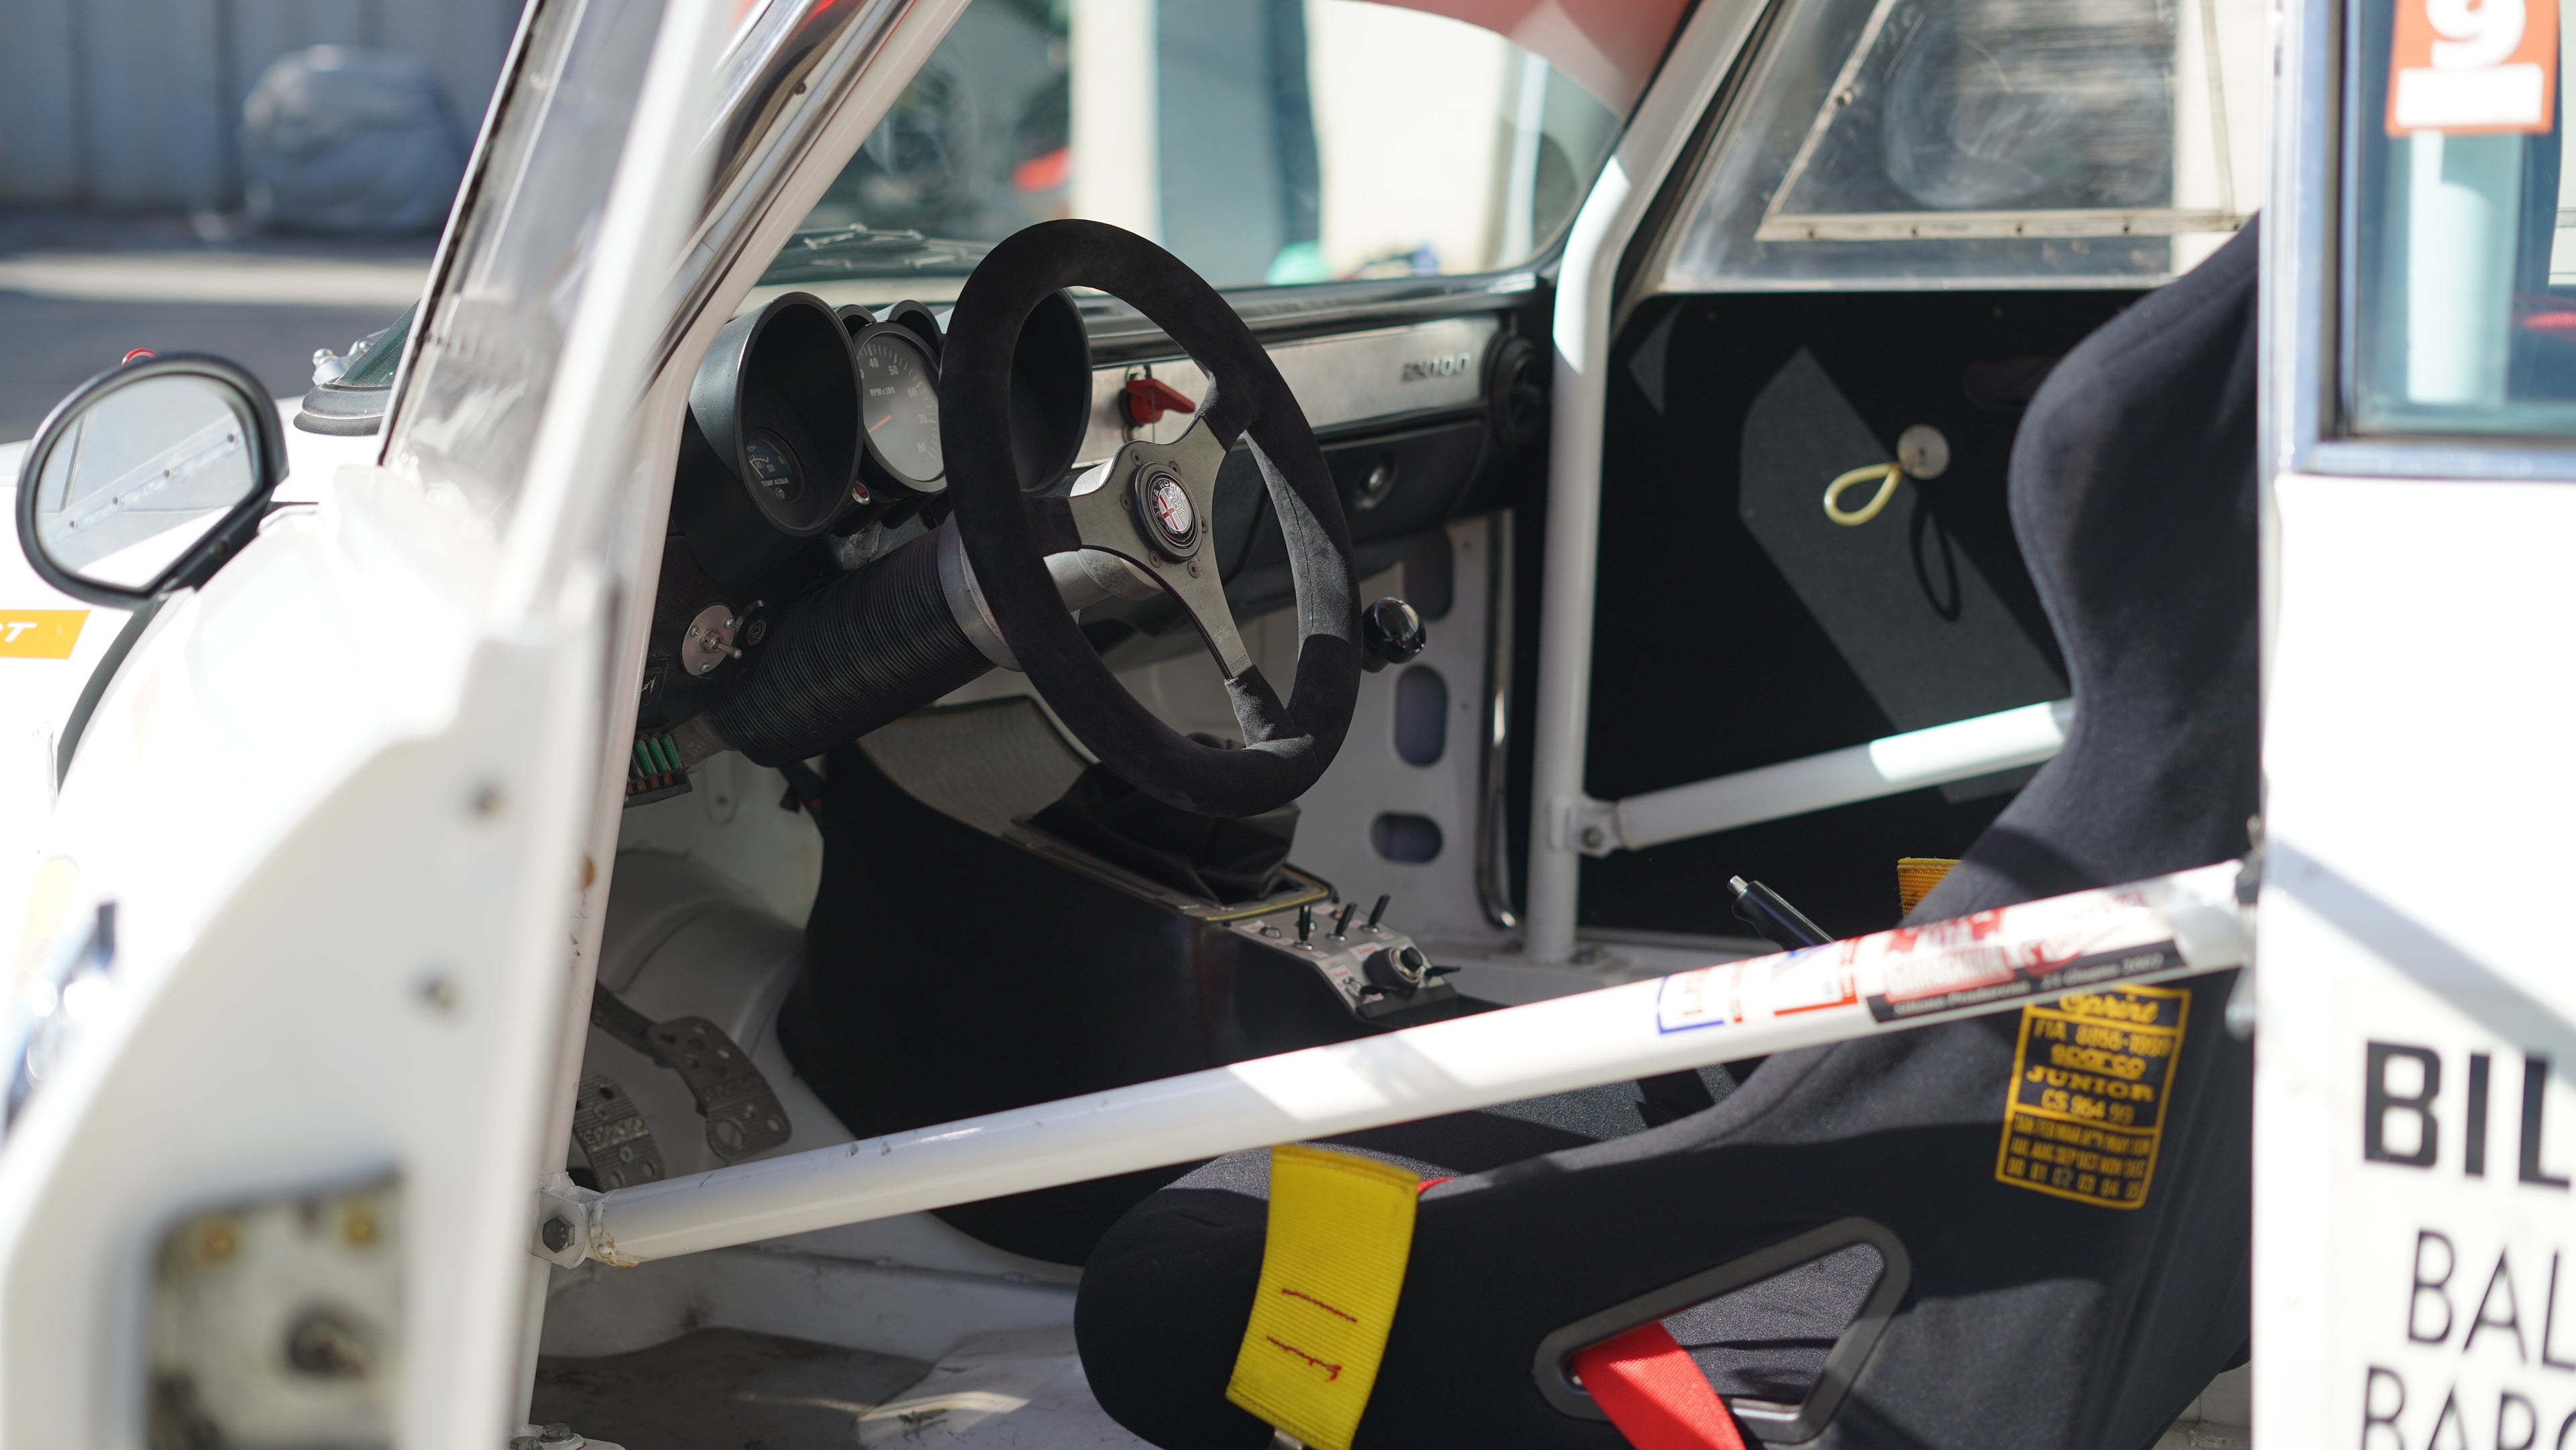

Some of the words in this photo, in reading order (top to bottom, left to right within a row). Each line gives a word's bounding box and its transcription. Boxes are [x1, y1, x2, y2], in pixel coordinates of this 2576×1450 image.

[869, 358, 879, 368] 40
[888, 365, 899, 376] 50
[869, 386, 882, 397] RPM
[907, 386, 918, 397] 60
[918, 414, 928, 425] 70
[917, 443, 927, 453] 80
[1152, 489, 1162, 518] ALFA
[1159, 479, 1187, 500] ROMEO
[2034, 1019, 2067, 1041] FIA
[2026, 1065, 2155, 1102] JUNIOR
[2363, 1038, 2571, 1190] BIL
[2407, 1228, 2576, 1371] BAL
